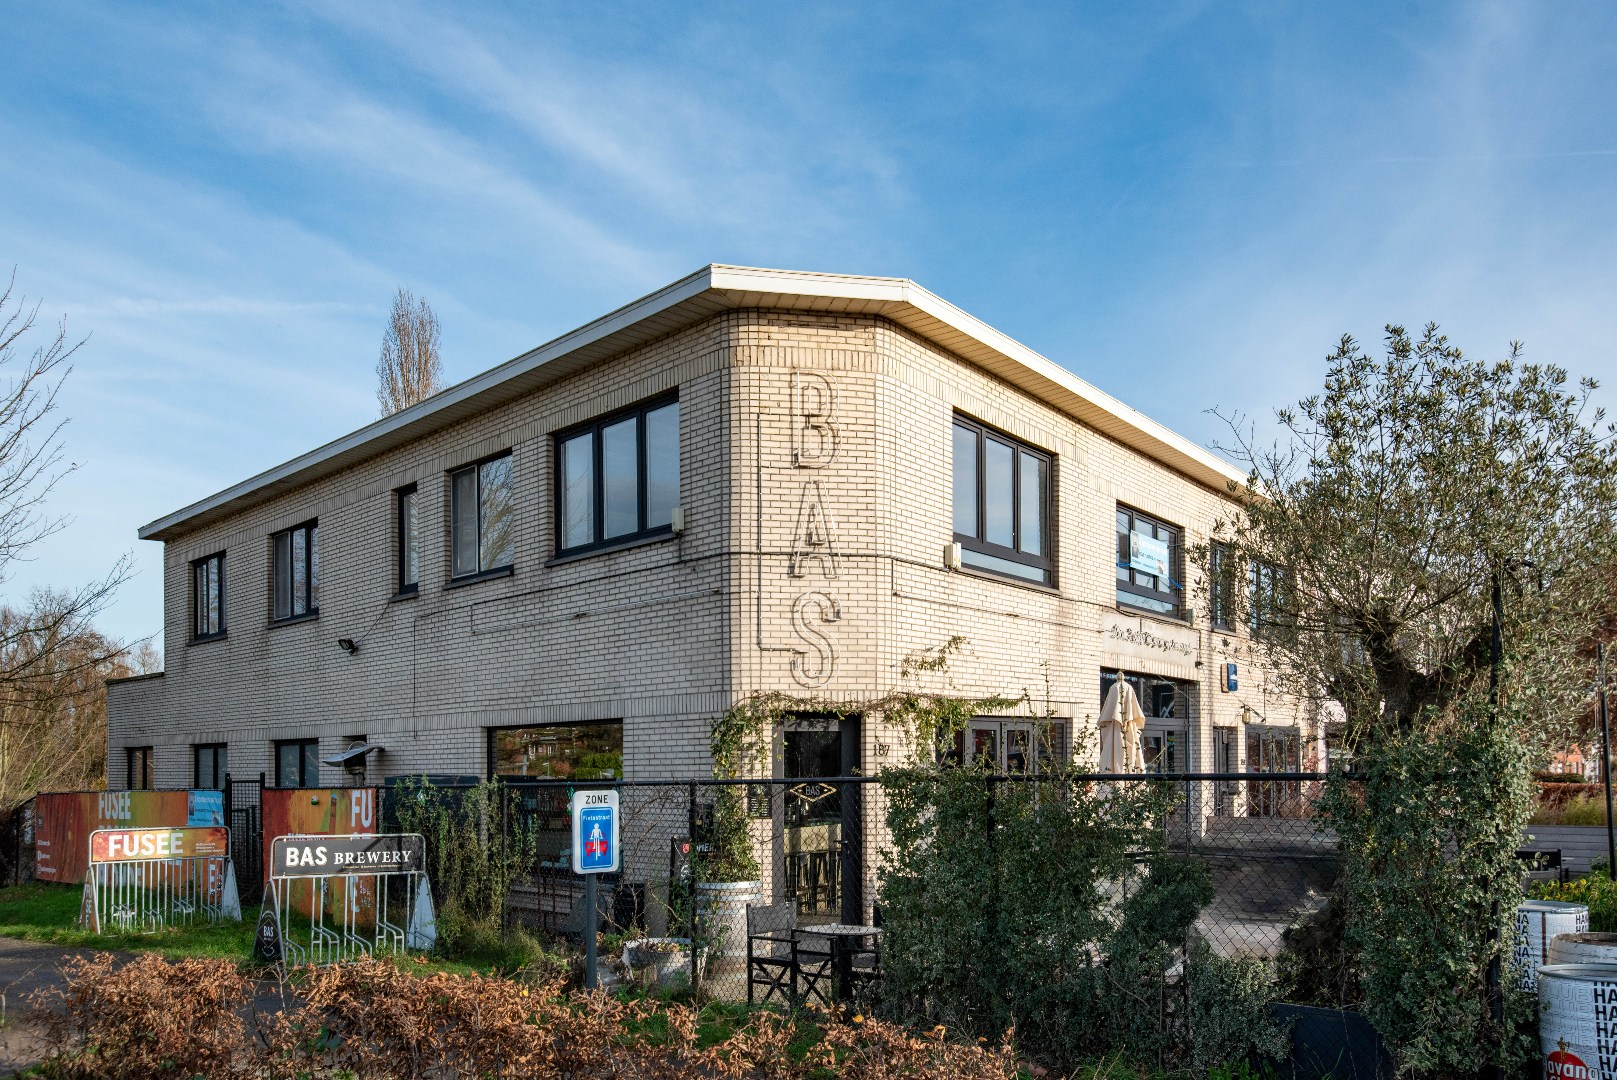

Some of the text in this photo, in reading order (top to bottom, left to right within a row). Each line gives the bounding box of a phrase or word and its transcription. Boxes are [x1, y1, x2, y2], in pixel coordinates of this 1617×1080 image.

[790, 368, 844, 688] BAS
[873, 743, 890, 756] 187
[585, 794, 609, 804] ZONE
[805, 785, 821, 796] BAS
[98, 790, 131, 819] FUSEE
[351, 789, 372, 828] FU
[108, 832, 184, 858] FUSEE
[286, 846, 412, 867] BAS BREWERY
[263, 925, 274, 937] BAS
